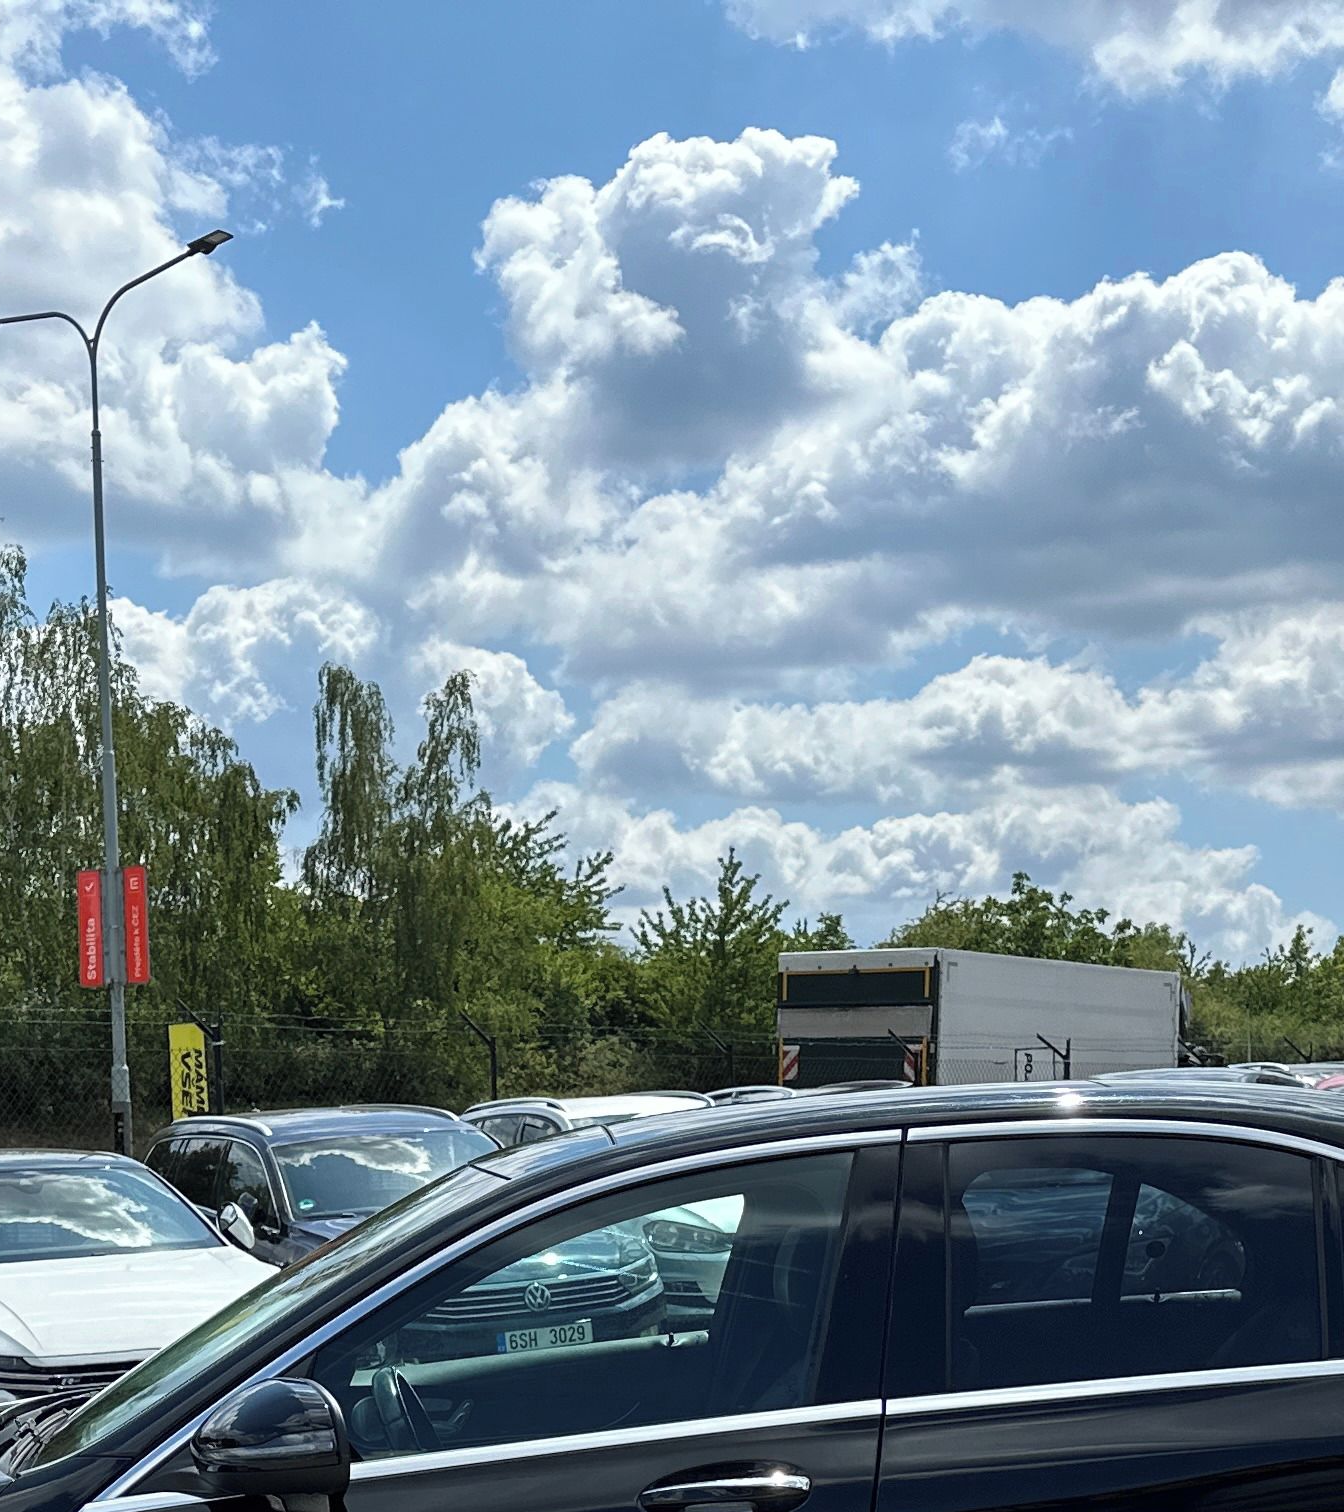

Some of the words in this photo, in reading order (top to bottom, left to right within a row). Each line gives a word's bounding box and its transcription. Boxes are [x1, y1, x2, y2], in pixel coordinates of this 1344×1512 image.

[86, 917, 97, 980] Stabilita
[509, 1331, 538, 1350] 6SH
[549, 1325, 586, 1345] 3029
